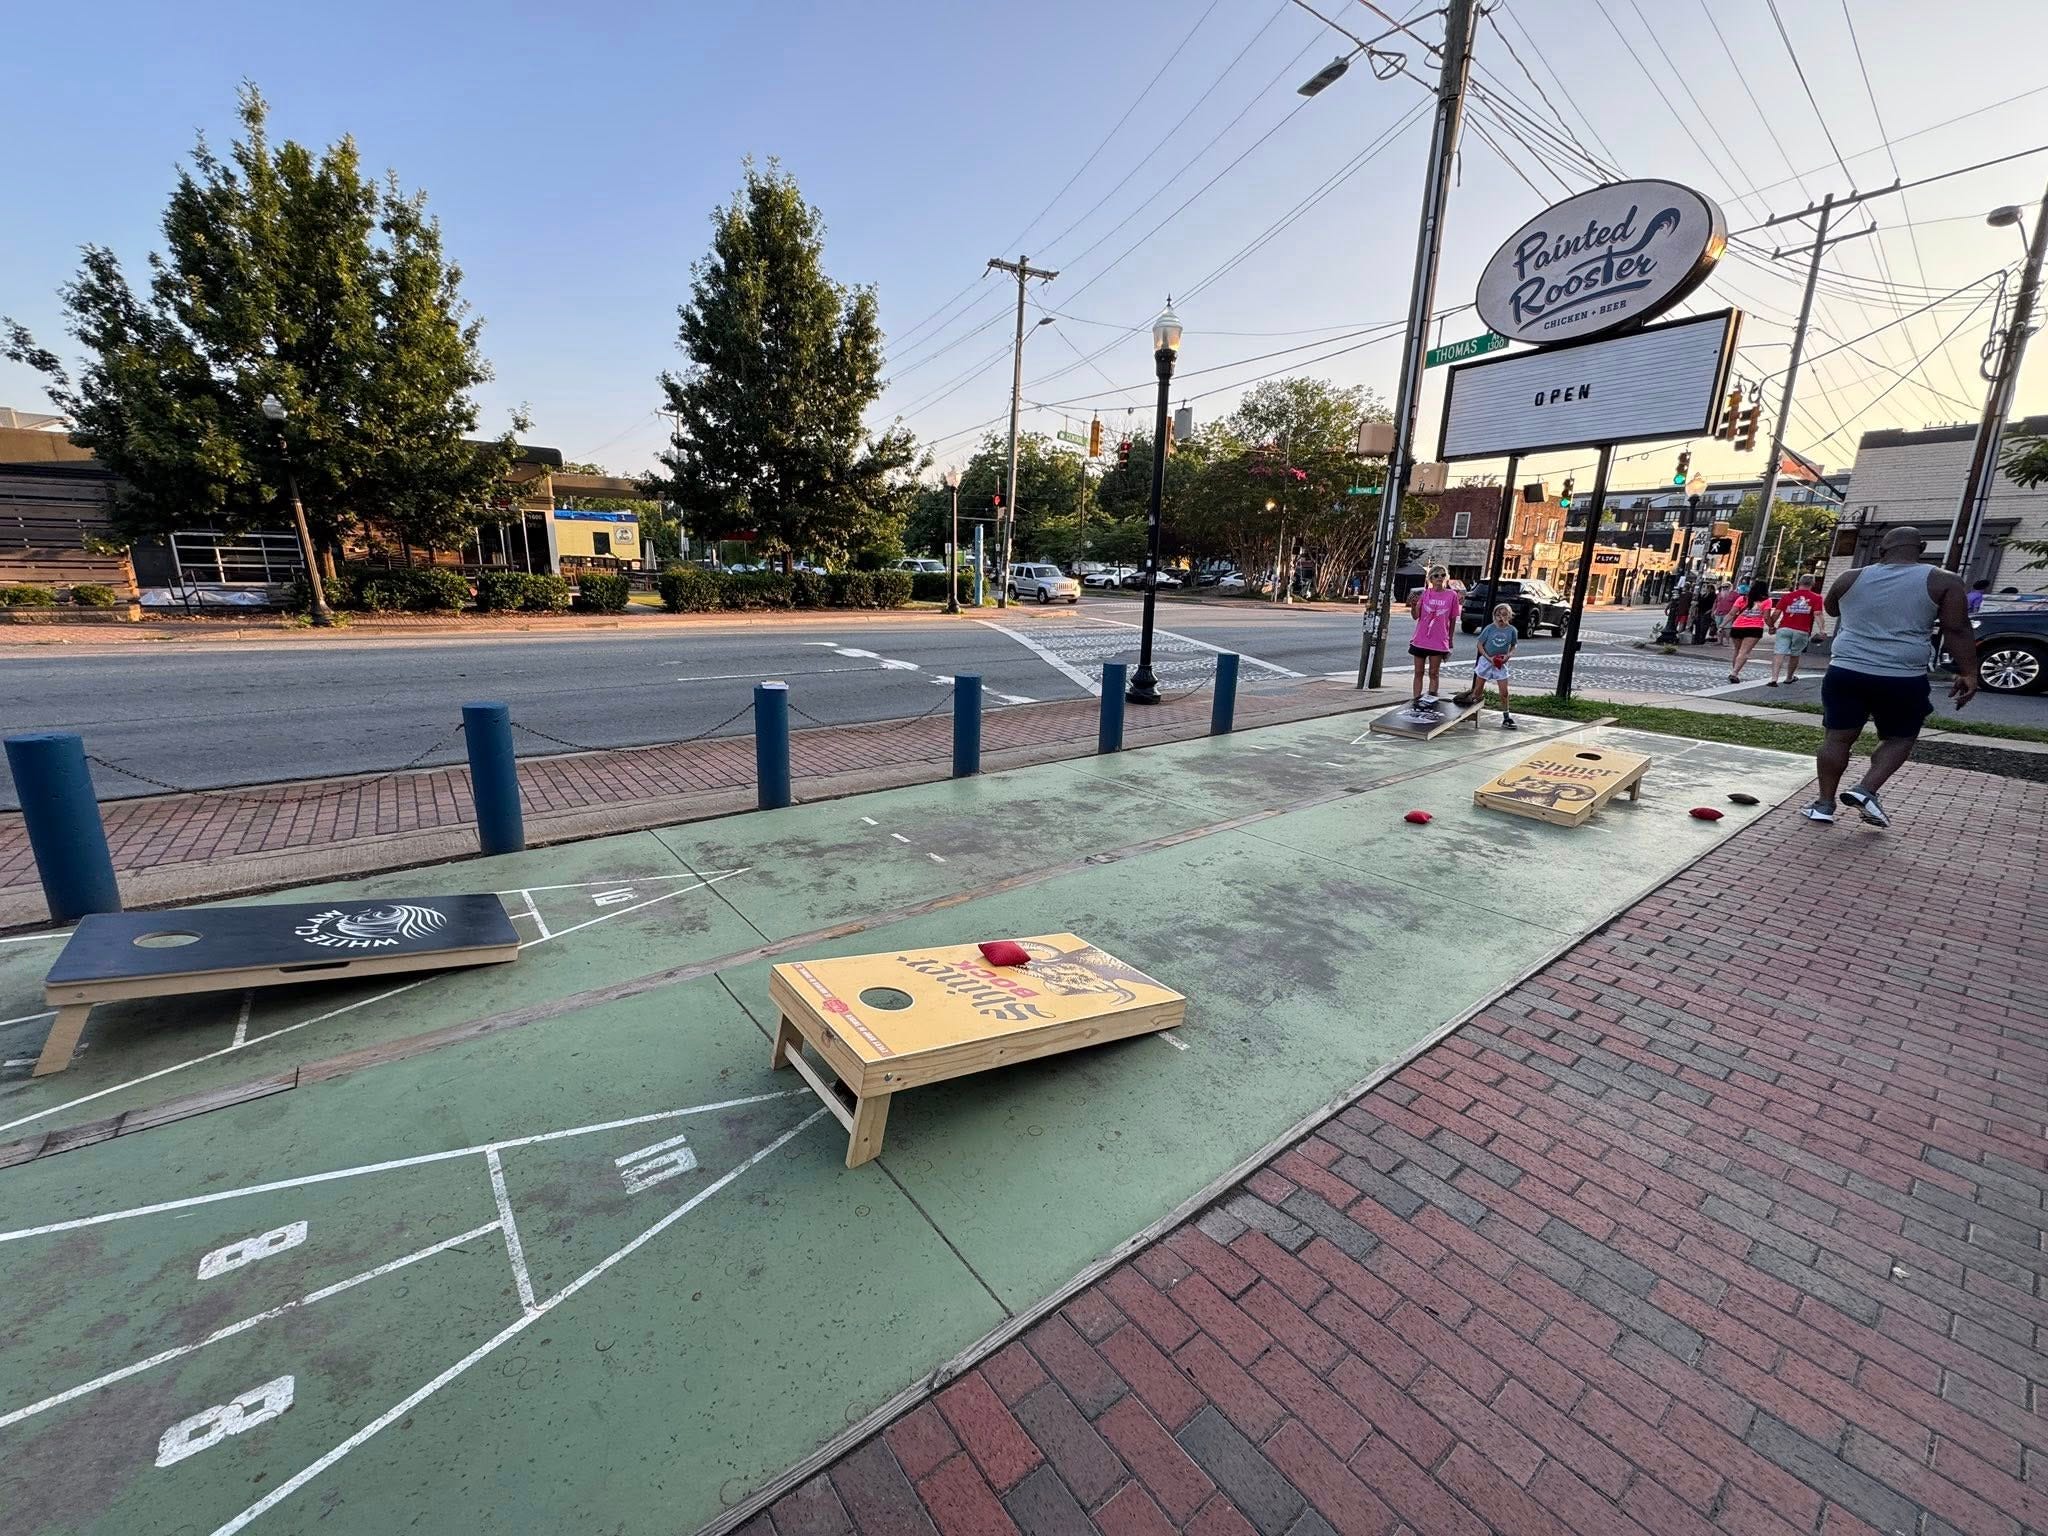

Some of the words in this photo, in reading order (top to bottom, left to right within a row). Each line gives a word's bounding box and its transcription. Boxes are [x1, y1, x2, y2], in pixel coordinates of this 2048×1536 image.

[1512, 205, 1639, 282] Painted
[1509, 245, 1657, 324] Rooster
[1543, 310, 1588, 330] CHICKEN
[1599, 299, 1628, 316] BEER
[1435, 340, 1477, 362] THOMAS
[1487, 338, 1505, 351] 1300
[1534, 383, 1592, 407] OPEN
[1519, 759, 1622, 778] Shiner
[1538, 770, 1598, 781] BOCK
[294, 909, 343, 936] CLAW
[304, 937, 399, 949] WHITE
[897, 955, 1056, 1021] Shiner
[951, 960, 1040, 998] BOCK
[196, 1220, 308, 1281] 8
[154, 1374, 295, 1468] 8
